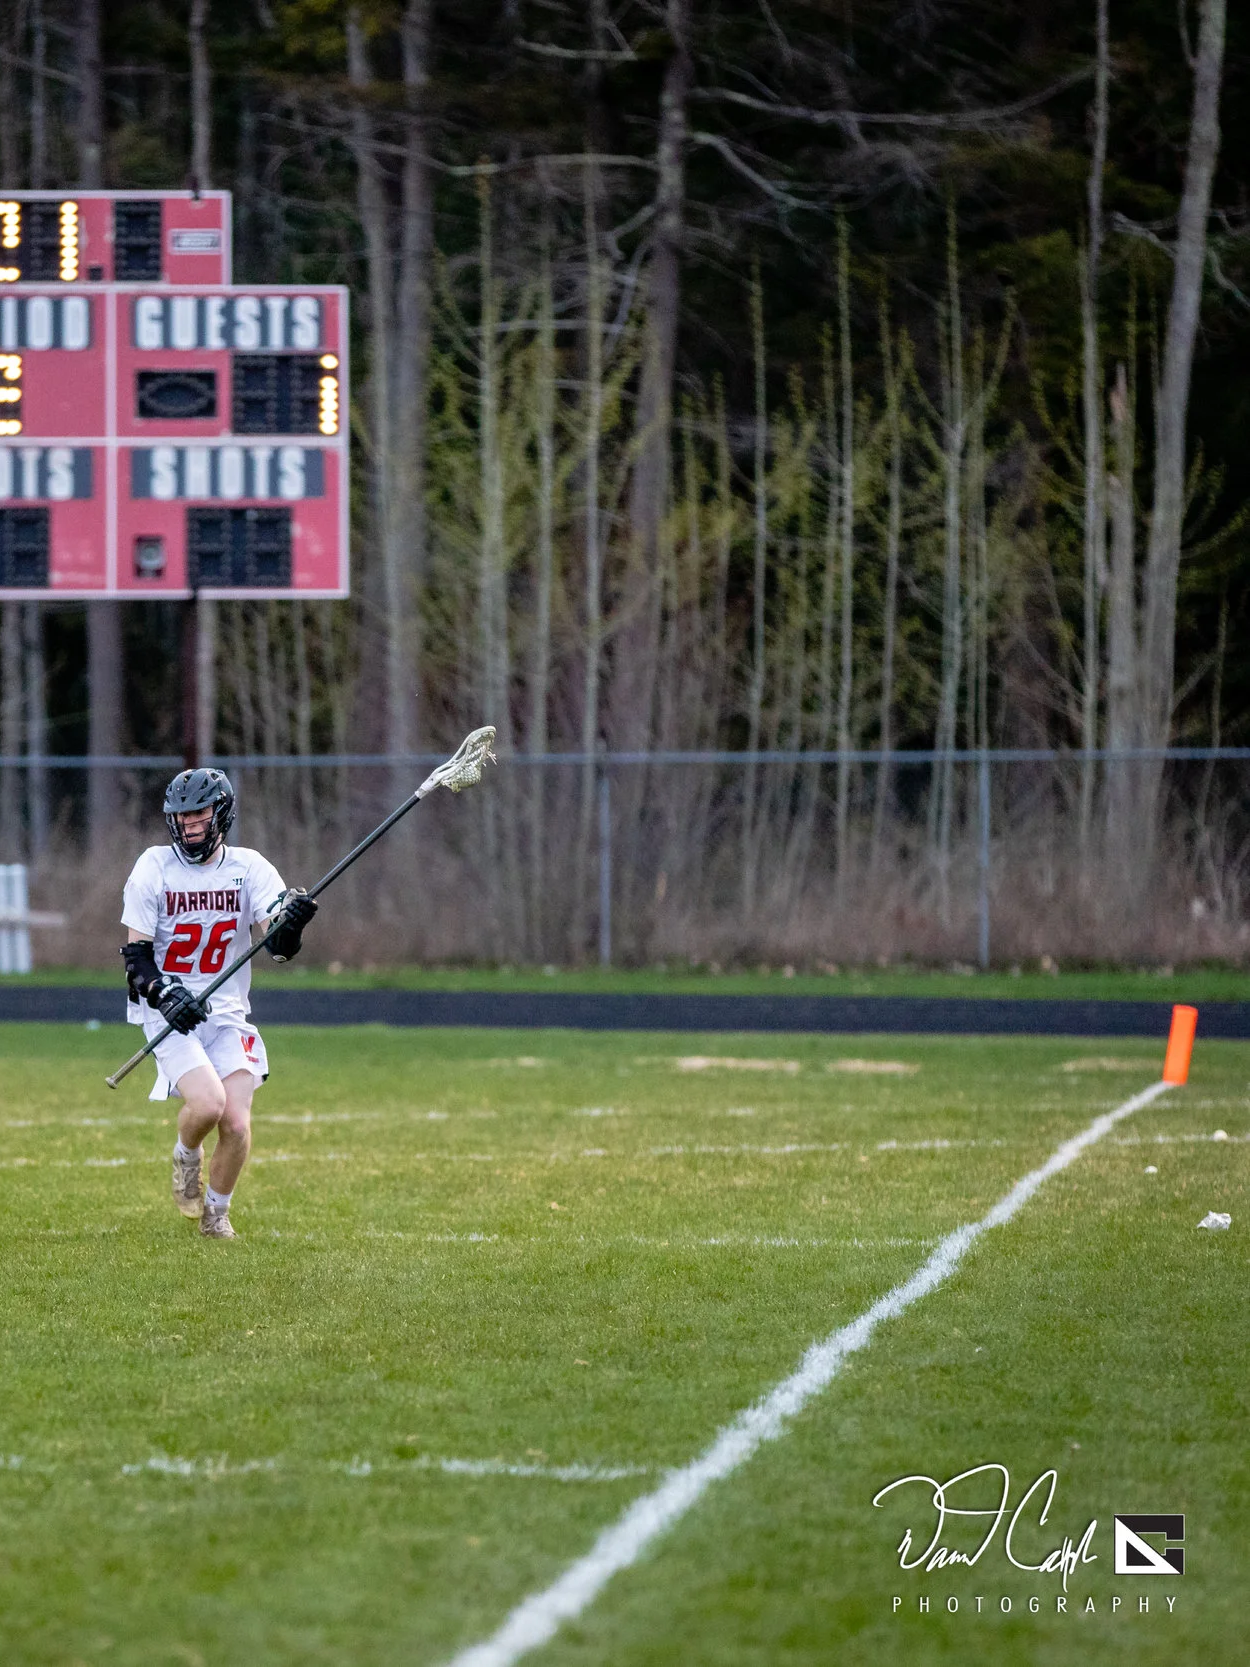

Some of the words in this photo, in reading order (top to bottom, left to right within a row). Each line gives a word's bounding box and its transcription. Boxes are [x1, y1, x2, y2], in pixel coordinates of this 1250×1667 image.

[136, 296, 320, 350] GUESTS
[151, 447, 306, 499] SHOTS
[162, 918, 238, 974] 26
